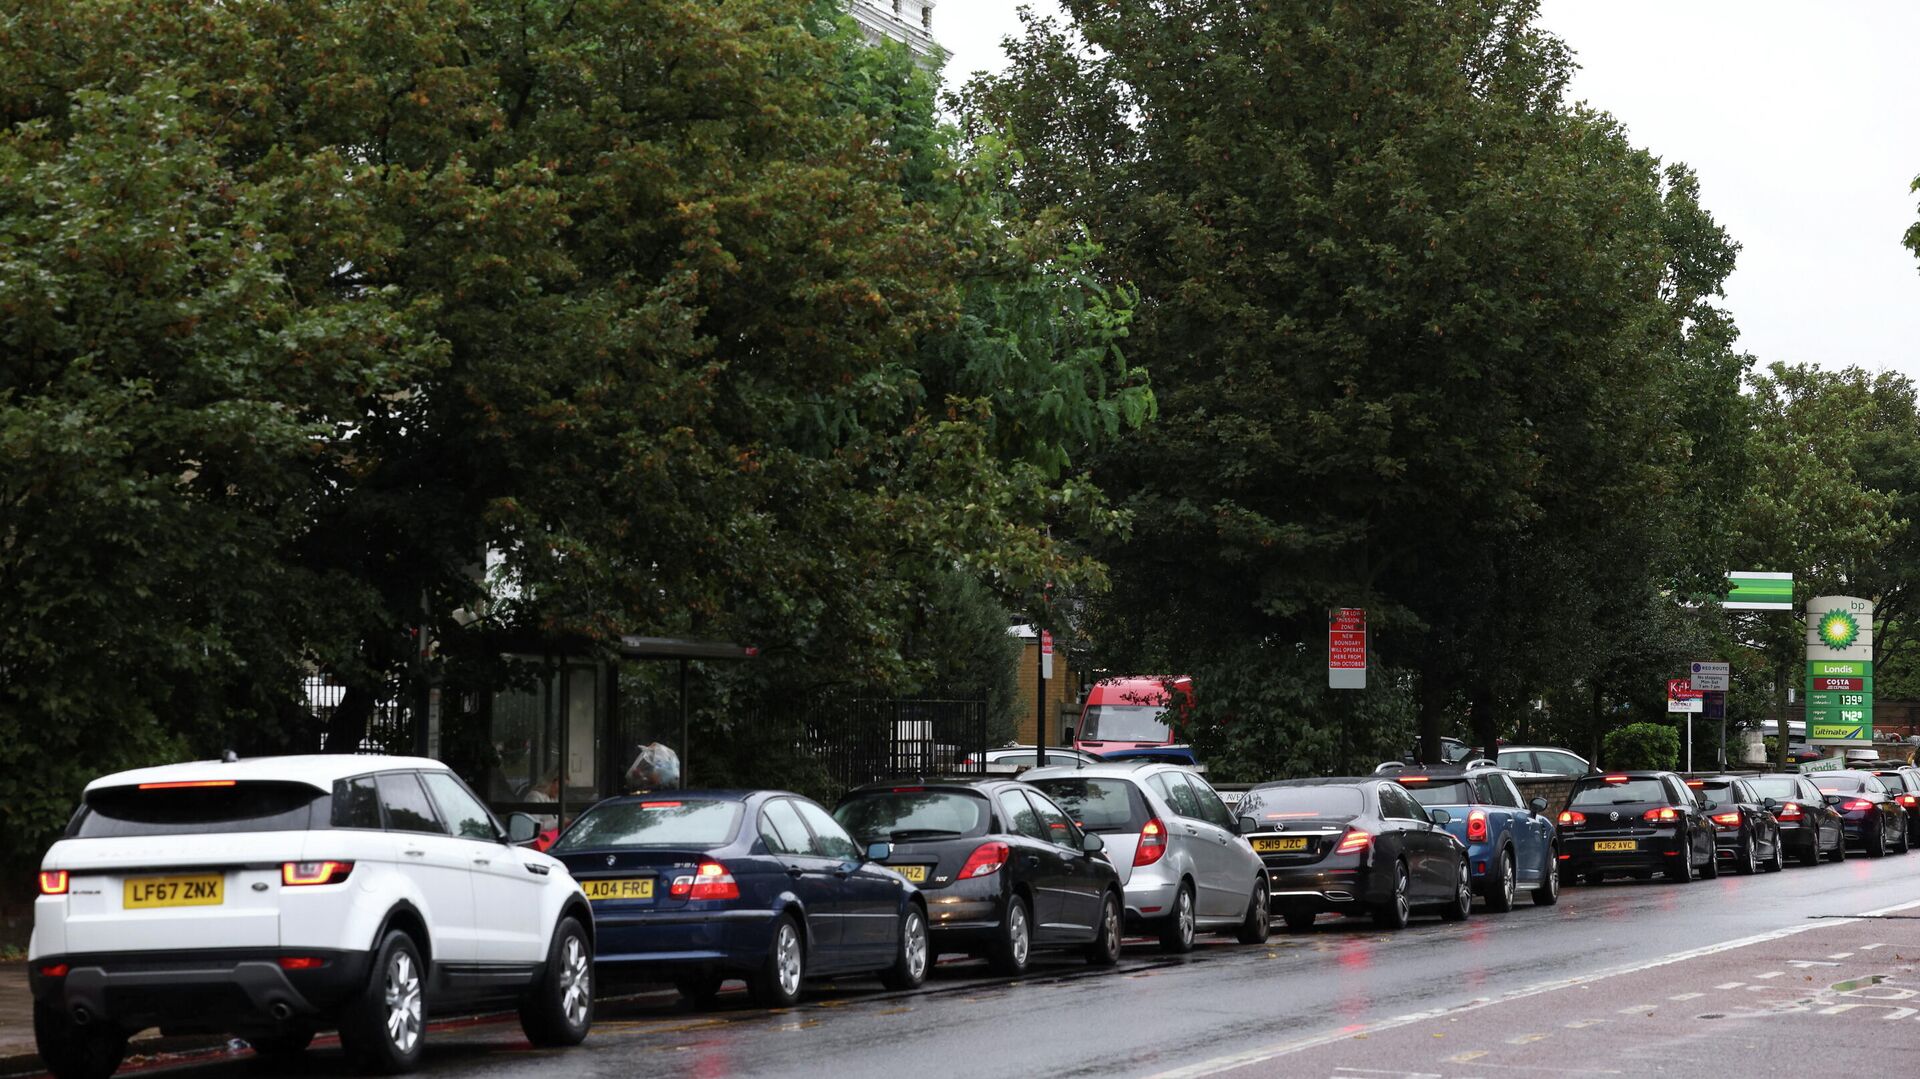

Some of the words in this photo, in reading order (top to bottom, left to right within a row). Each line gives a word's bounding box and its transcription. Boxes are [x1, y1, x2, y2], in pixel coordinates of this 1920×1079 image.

[1851, 601, 1865, 612] bp
[1825, 665, 1852, 674] Londis
[1815, 728, 1848, 736] ultimate
[1805, 762, 1837, 772] Londis
[1226, 793, 1245, 801] AVE
[1260, 841, 1281, 850] SM19
[1283, 840, 1302, 849] JZC
[133, 883, 180, 902] LF67
[183, 881, 218, 899] ZNX
[583, 881, 619, 897] LA04
[622, 880, 650, 896] FRC
